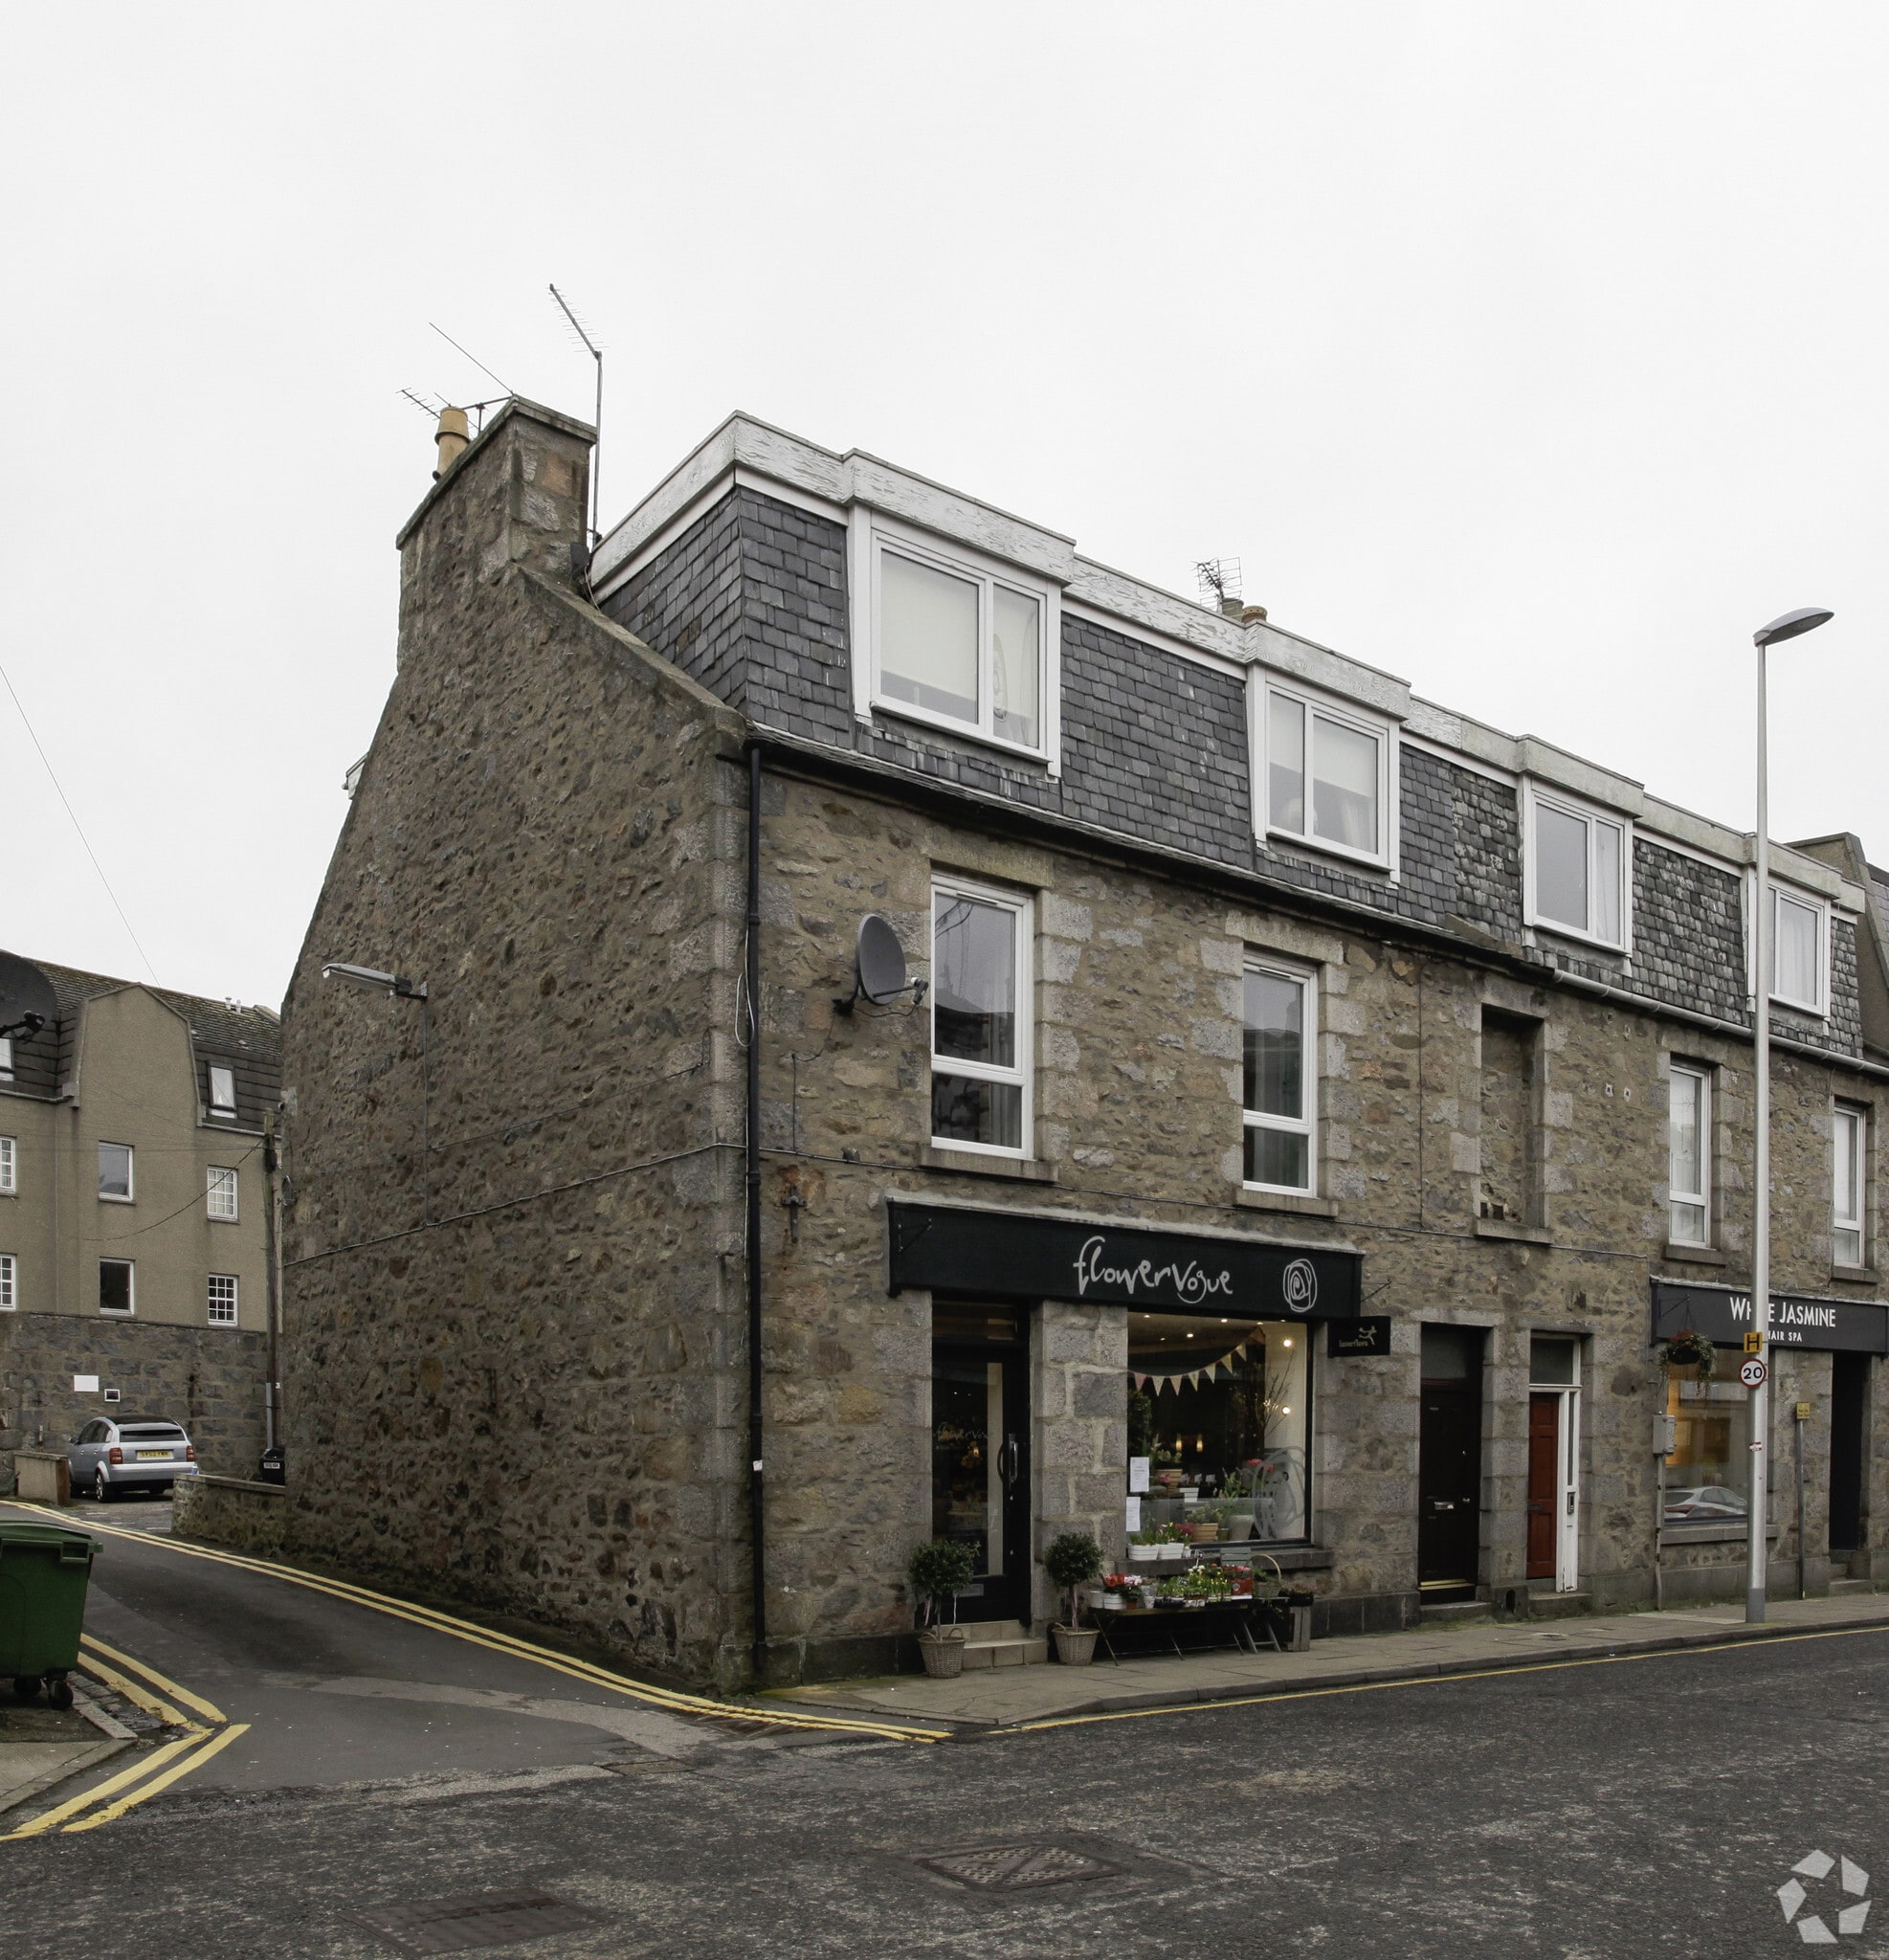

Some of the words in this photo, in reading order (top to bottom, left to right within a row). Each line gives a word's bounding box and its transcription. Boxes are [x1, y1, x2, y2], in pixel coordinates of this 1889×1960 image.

[1779, 1302, 1836, 1328] JASMINE
[1746, 1333, 1760, 1351] H
[1788, 1331, 1803, 1343] SPA
[1743, 1367, 1763, 1380] 20
